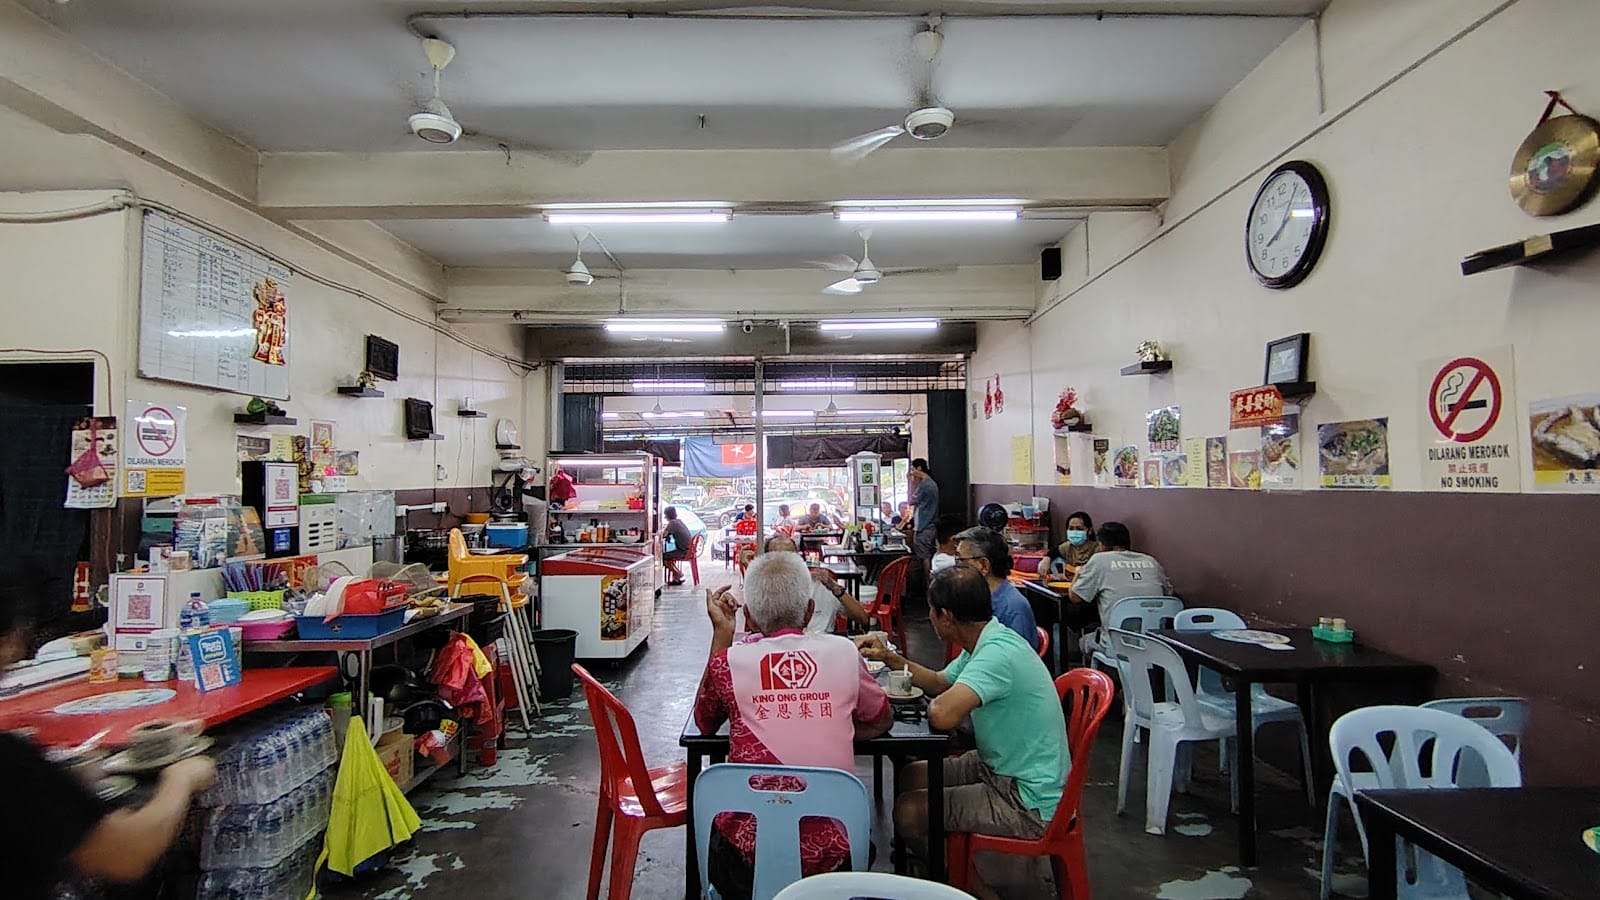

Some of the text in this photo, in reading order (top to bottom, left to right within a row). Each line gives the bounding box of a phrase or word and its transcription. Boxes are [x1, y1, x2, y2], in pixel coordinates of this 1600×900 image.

[1277, 182, 1287, 196] 12
[1266, 195, 1275, 208] 11
[1259, 213, 1268, 225] 10
[1257, 233, 1264, 244] 9
[1261, 249, 1268, 260] 8
[1294, 245, 1301, 257] 5
[1270, 258, 1276, 269] 7
[1282, 257, 1289, 269] 6
[1428, 444, 1510, 461] DILARANG MEROKOK
[127, 457, 184, 466] DILARANG MEROKOK
[1440, 476, 1499, 488] NO SMOKING
[752, 692, 830, 704] KING ONG GROUP
